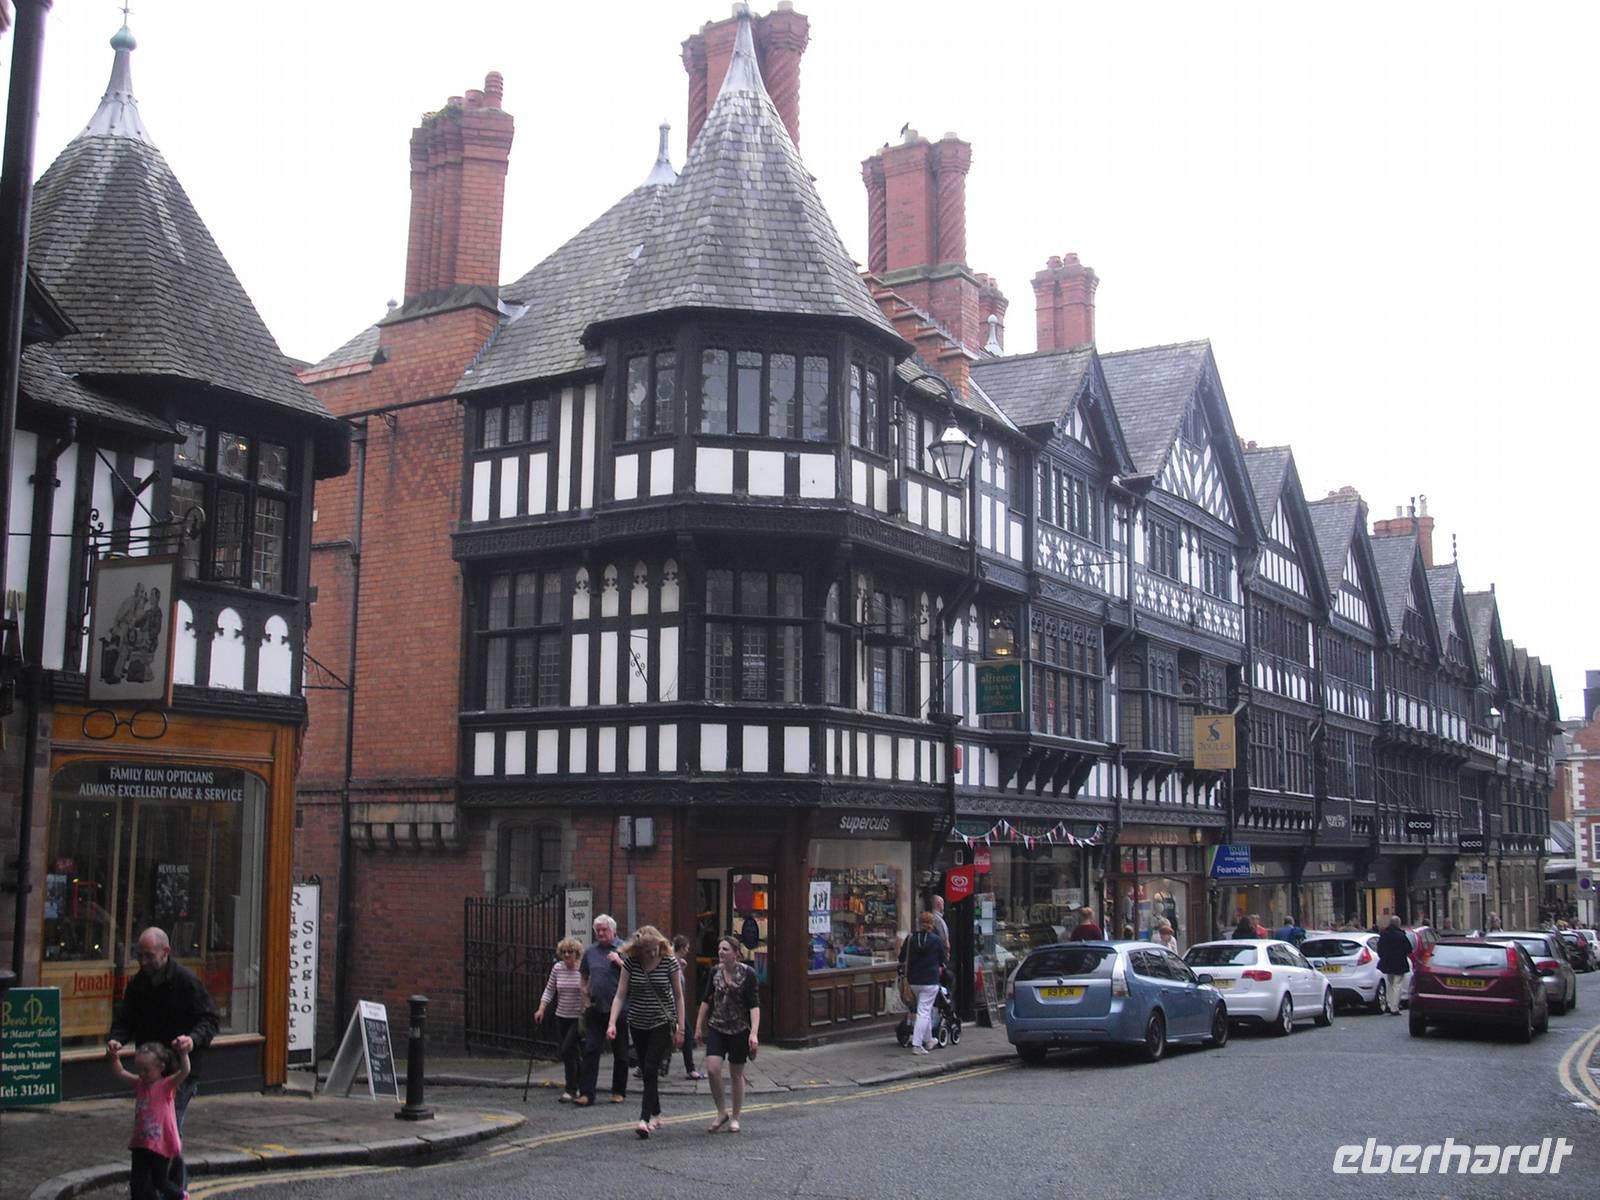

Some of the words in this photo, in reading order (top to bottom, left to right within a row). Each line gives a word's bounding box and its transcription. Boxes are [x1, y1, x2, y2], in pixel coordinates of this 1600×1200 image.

[110, 767, 142, 782] FAMILY
[144, 769, 165, 783] RUN
[166, 770, 214, 785] OPTICIANS
[79, 783, 116, 797] ALWAYS
[118, 785, 168, 799] EXCELLENT
[170, 787, 194, 800] CARE
[195, 788, 203, 800] &
[204, 788, 243, 801] SERVICE
[839, 815, 890, 834] supercuts
[1408, 821, 1431, 829] ecco
[1461, 840, 1482, 848] ecco
[1216, 865, 1249, 874] Fearnalls
[301, 920, 314, 1014] Sergio
[10, 1030, 35, 1038] Master
[36, 1028, 57, 1037] Tailor
[18, 1051, 26, 1059] to
[27, 1050, 56, 1058] Measure
[1, 1063, 30, 1072] Bespoke
[31, 1062, 52, 1070] Tailor
[20, 1083, 55, 1097] 312611
